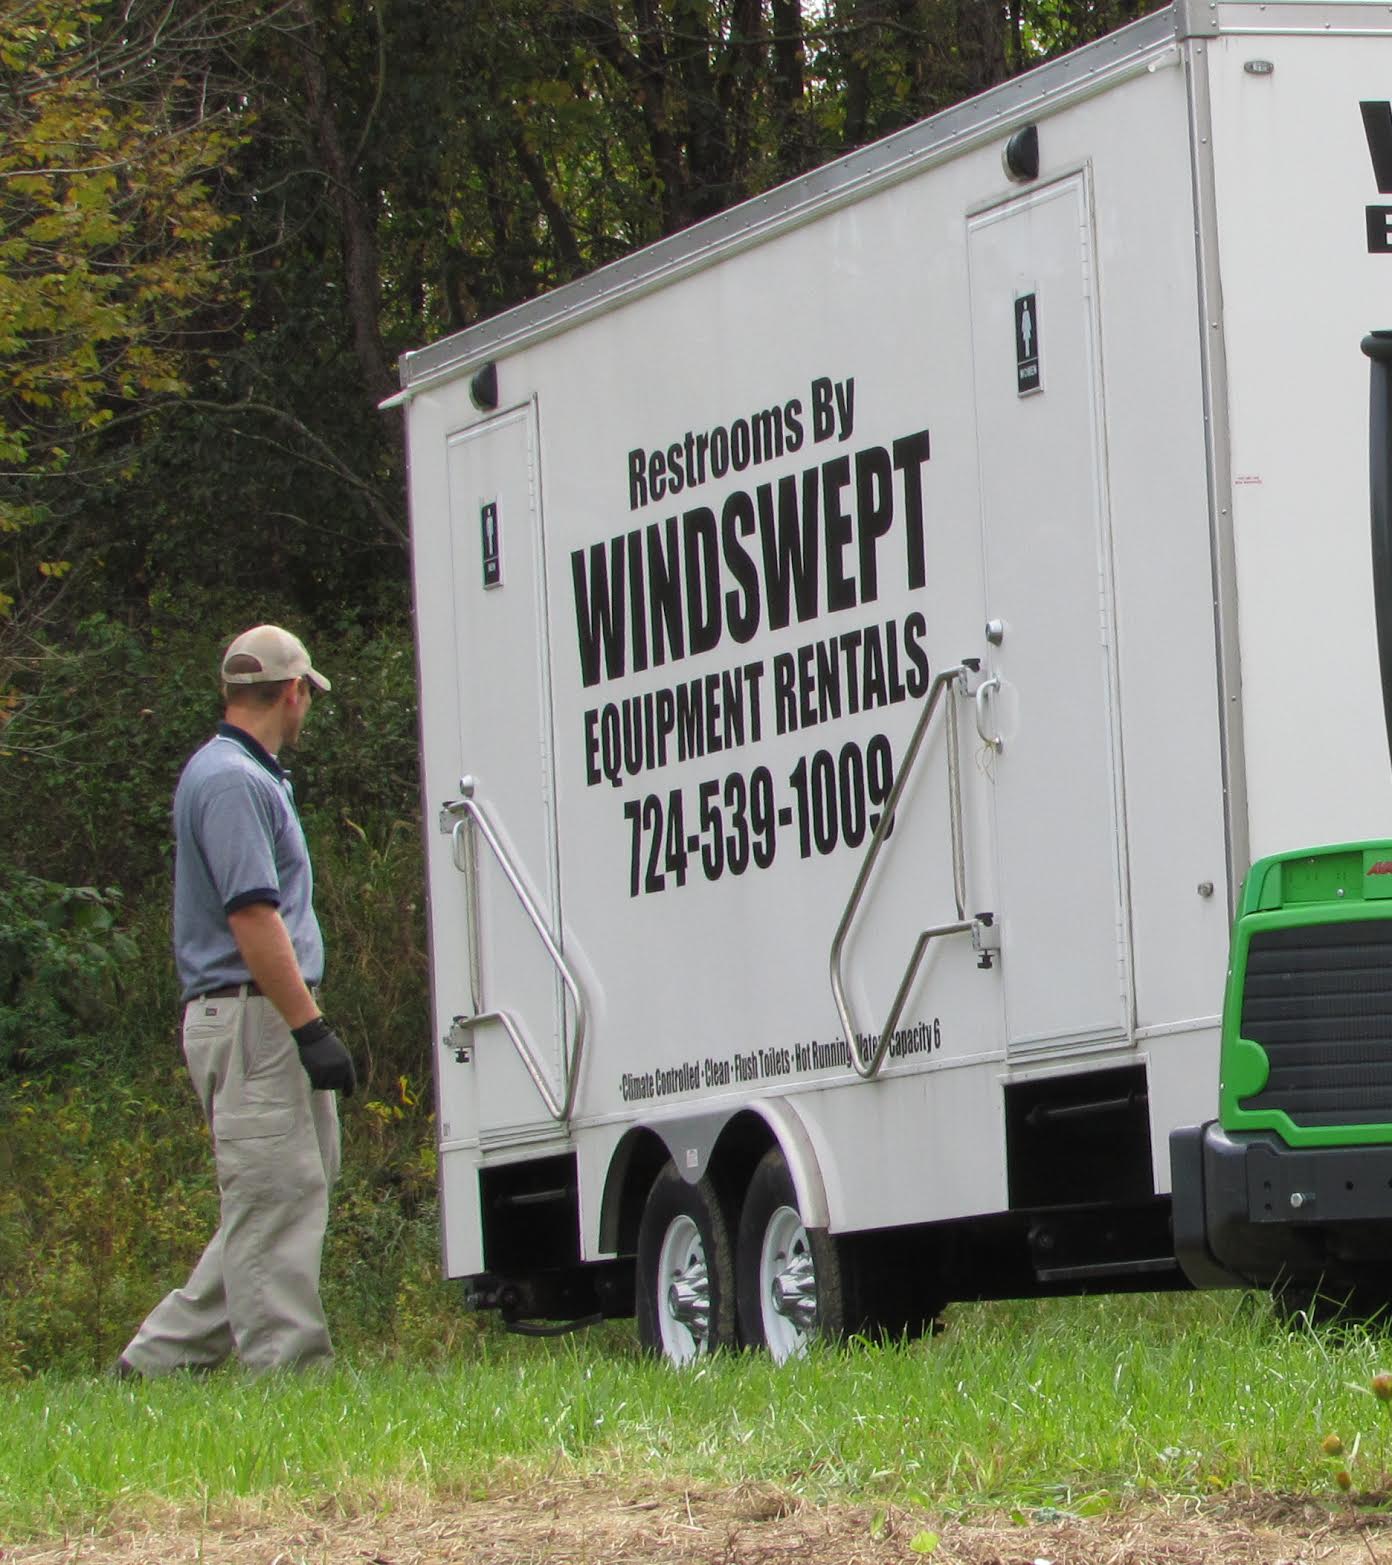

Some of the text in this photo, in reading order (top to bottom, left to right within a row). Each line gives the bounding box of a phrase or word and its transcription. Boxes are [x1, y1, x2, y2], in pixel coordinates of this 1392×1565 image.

[629, 377, 855, 511] Restrooms By
[570, 430, 930, 689] WINDSWEPT
[585, 612, 930, 788] EQUIPMENT RENTALS
[624, 734, 895, 898] 724-539-1009
[622, 1072, 655, 1102] Climate
[655, 1060, 701, 1096] Controlled
[704, 1058, 731, 1088] Clean
[734, 1051, 759, 1083] Flush
[759, 1046, 791, 1078] Toilets
[794, 1041, 811, 1072] Hot
[812, 1036, 853, 1069] Running
[889, 1022, 932, 1059] Capacity
[933, 1017, 942, 1050] 6
